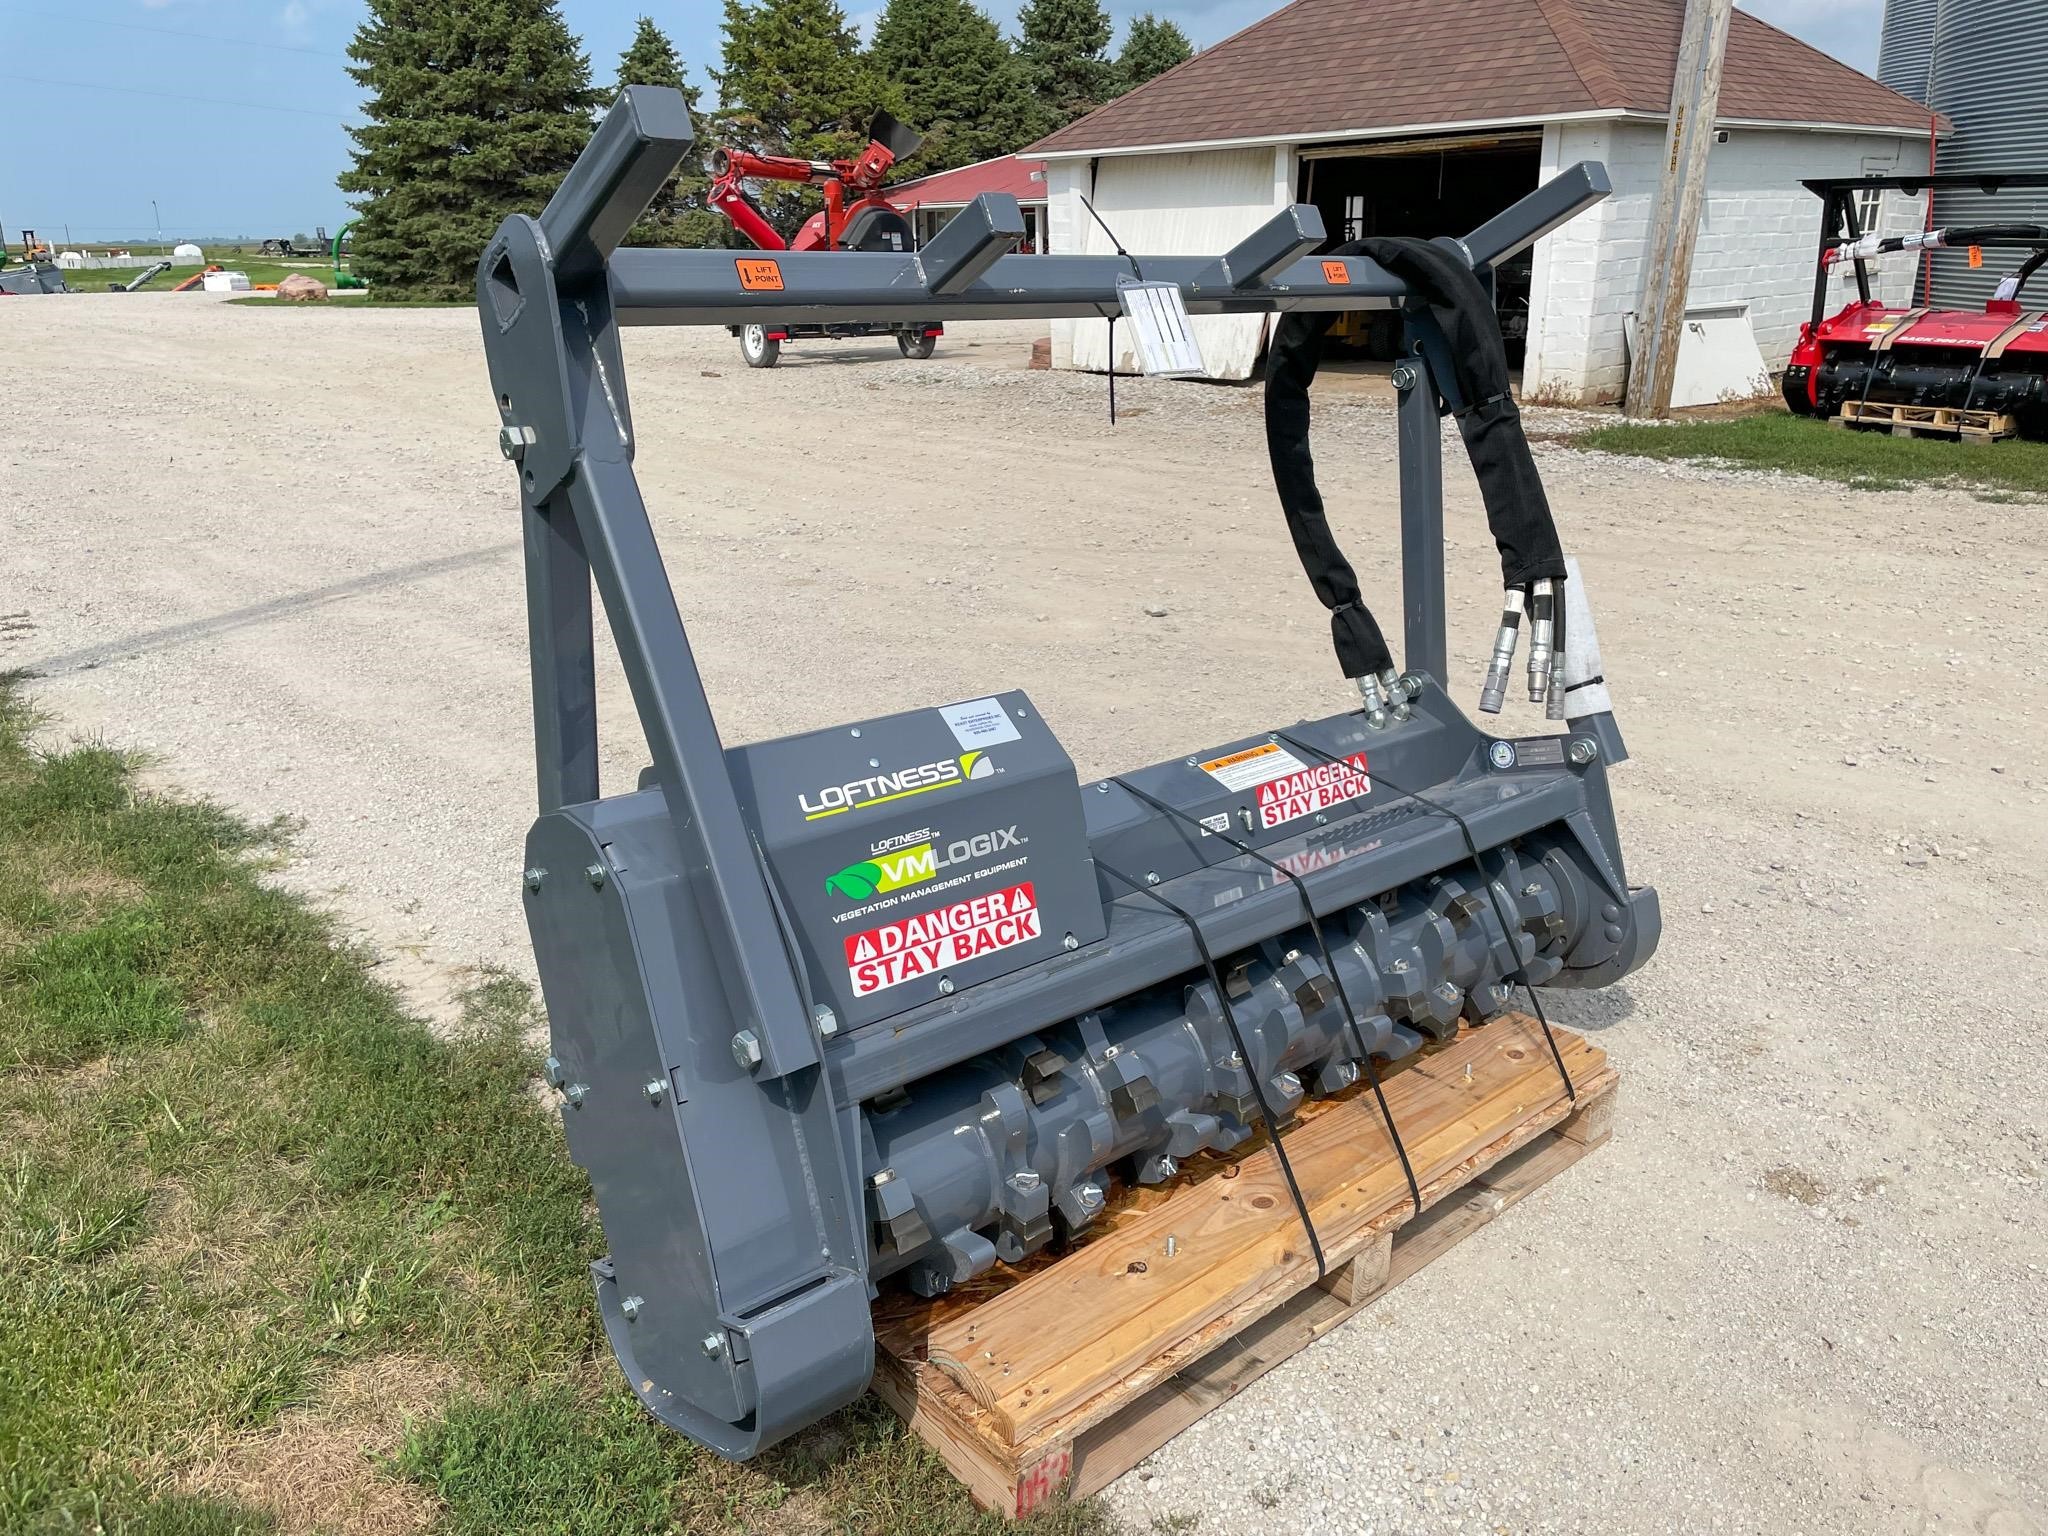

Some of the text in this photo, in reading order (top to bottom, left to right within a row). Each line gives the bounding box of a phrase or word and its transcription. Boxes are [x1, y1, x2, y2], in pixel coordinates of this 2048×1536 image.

[1227, 751, 1260, 764] WARNING
[1274, 759, 1350, 801] DANGER
[798, 758, 959, 813] LOFTNESS
[1264, 776, 1368, 825] STAY BACK
[870, 827, 930, 853] LOFTNESS
[832, 856, 1028, 924] VEGETATION MANAGEMENT EQUIPMENT
[878, 894, 1008, 955] DANGER
[857, 913, 1038, 991] STAY BACK
